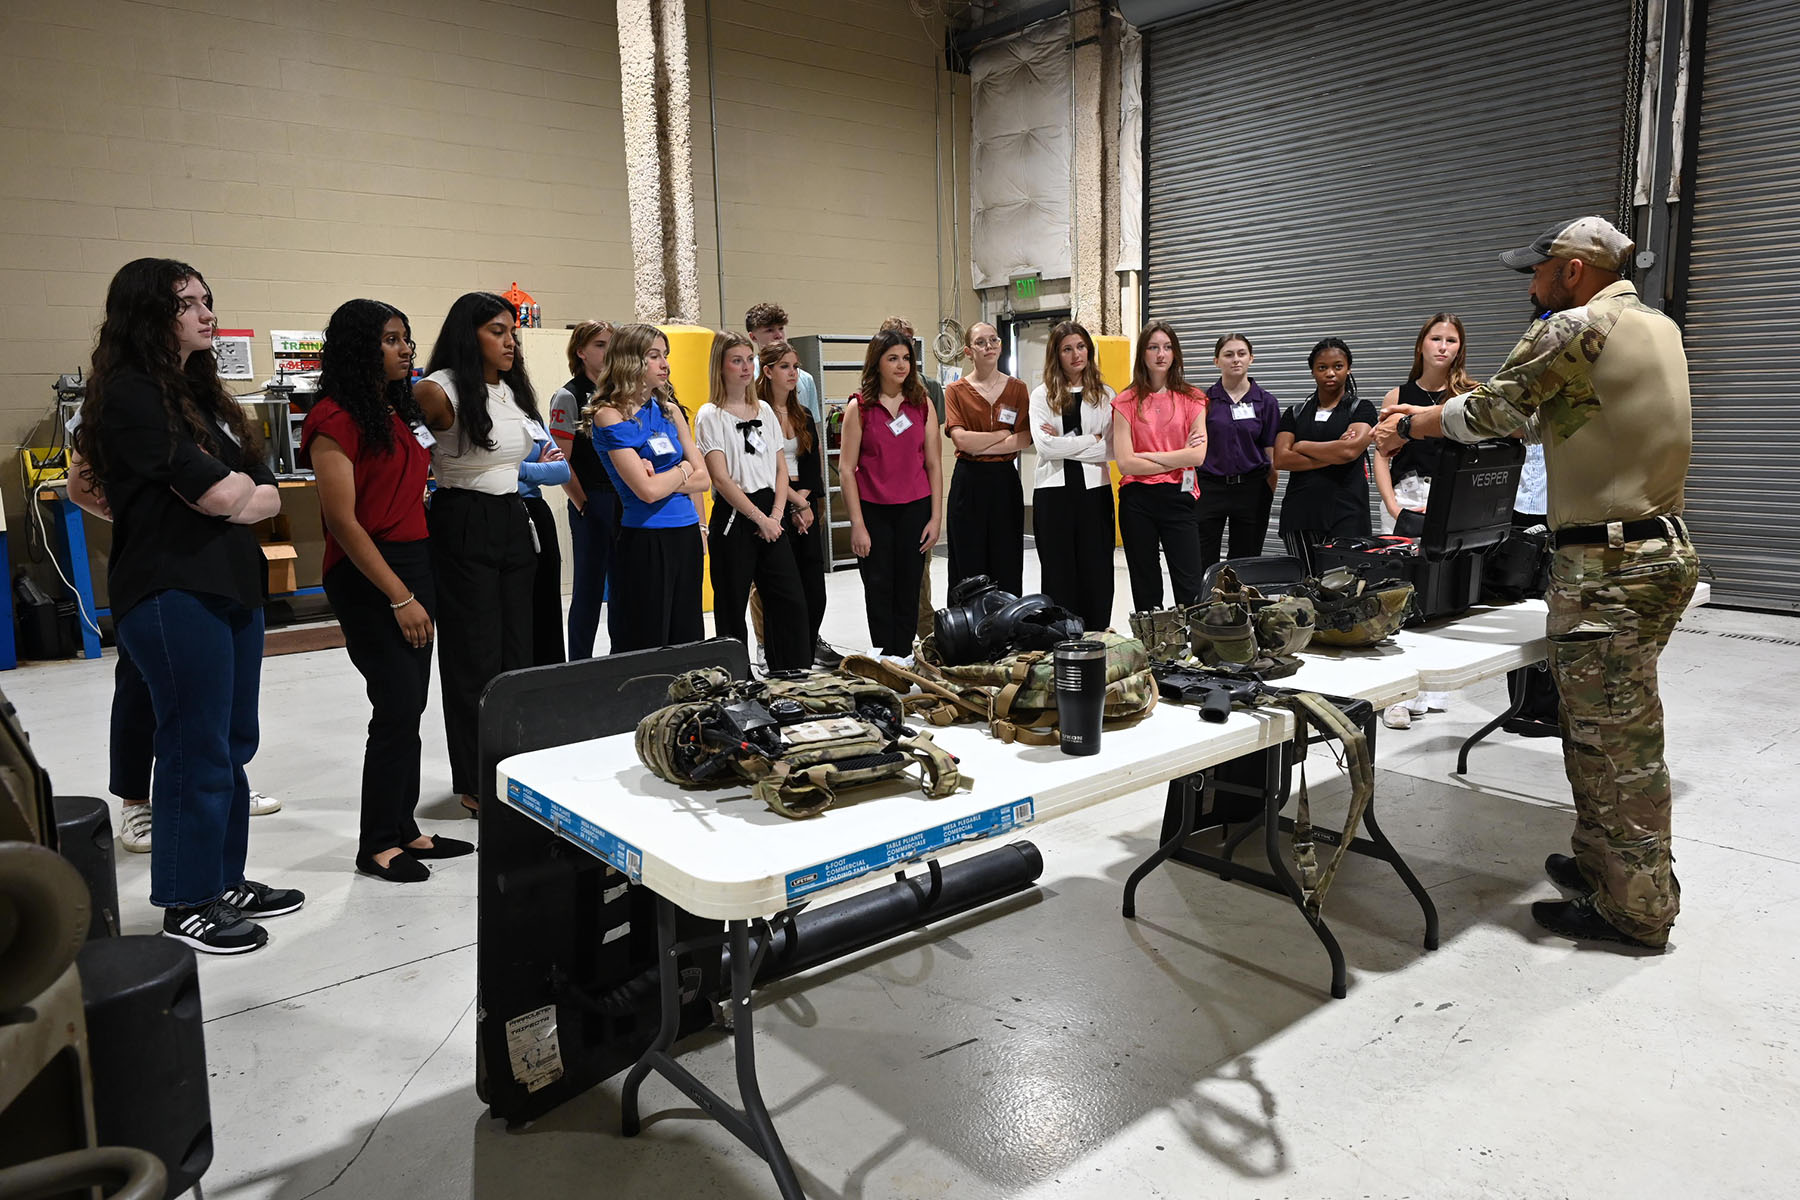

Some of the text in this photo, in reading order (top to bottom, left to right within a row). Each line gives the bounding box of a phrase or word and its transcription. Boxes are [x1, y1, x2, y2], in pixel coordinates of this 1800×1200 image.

[1016, 279, 1036, 297] EXIT
[1472, 471, 1508, 487] VESPER
[943, 814, 982, 832] MESA PLEGABLE
[943, 824, 973, 838] COMERCIAL
[886, 833, 924, 850] TABLE PLIANTE
[886, 838, 926, 857] COMMERCIALE
[825, 858, 846, 871] 6-FOOT
[826, 859, 866, 877] COMMERCIAL
[853, 864, 870, 875] TABLE
